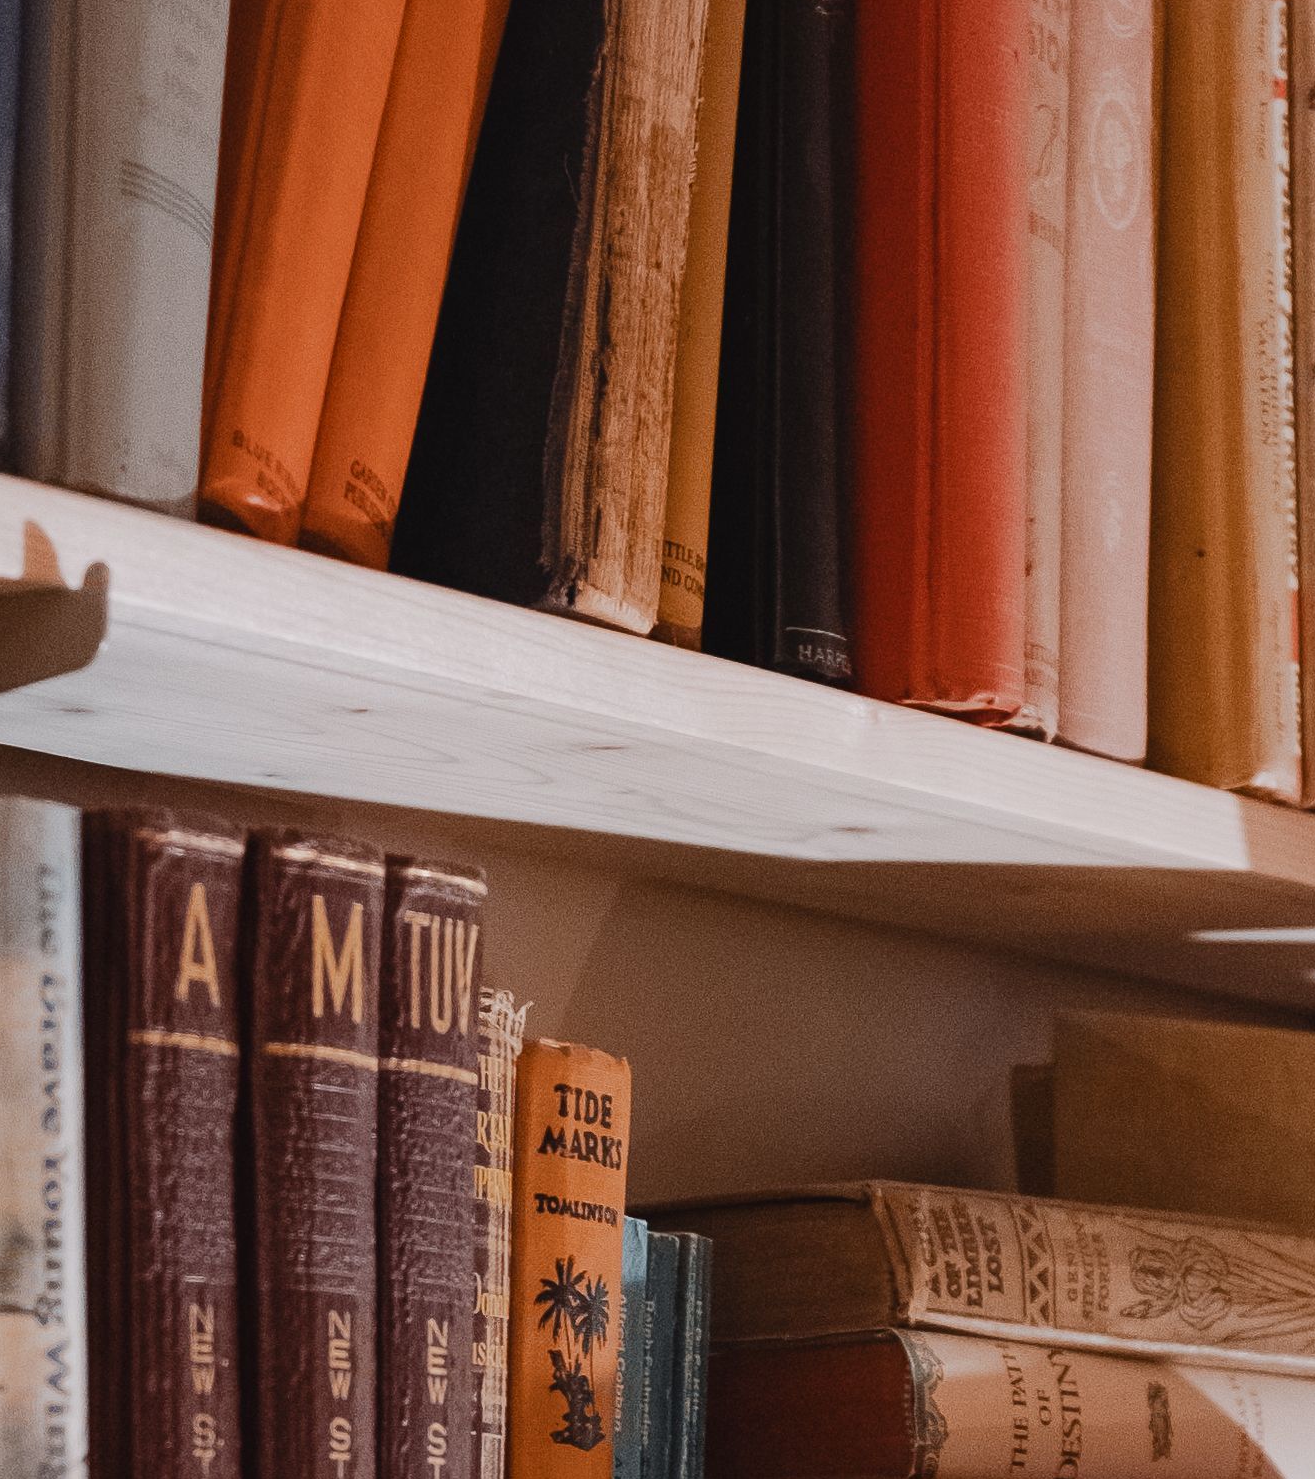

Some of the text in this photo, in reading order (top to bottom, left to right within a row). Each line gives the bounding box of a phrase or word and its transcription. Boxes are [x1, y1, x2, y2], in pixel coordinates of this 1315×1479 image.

[174, 882, 221, 1008] A
[312, 894, 364, 1024] M
[553, 1082, 615, 1130] TIDE
[537, 1124, 624, 1171] MARKS
[533, 1191, 619, 1229] TOMLINSON
[976, 1215, 1006, 1295] LOST
[188, 1303, 217, 1395] NEW
[326, 1308, 353, 1401] NEW
[425, 1317, 450, 1404] NEW
[1008, 1416, 1029, 1474] THE
[1036, 1388, 1053, 1427] OF
